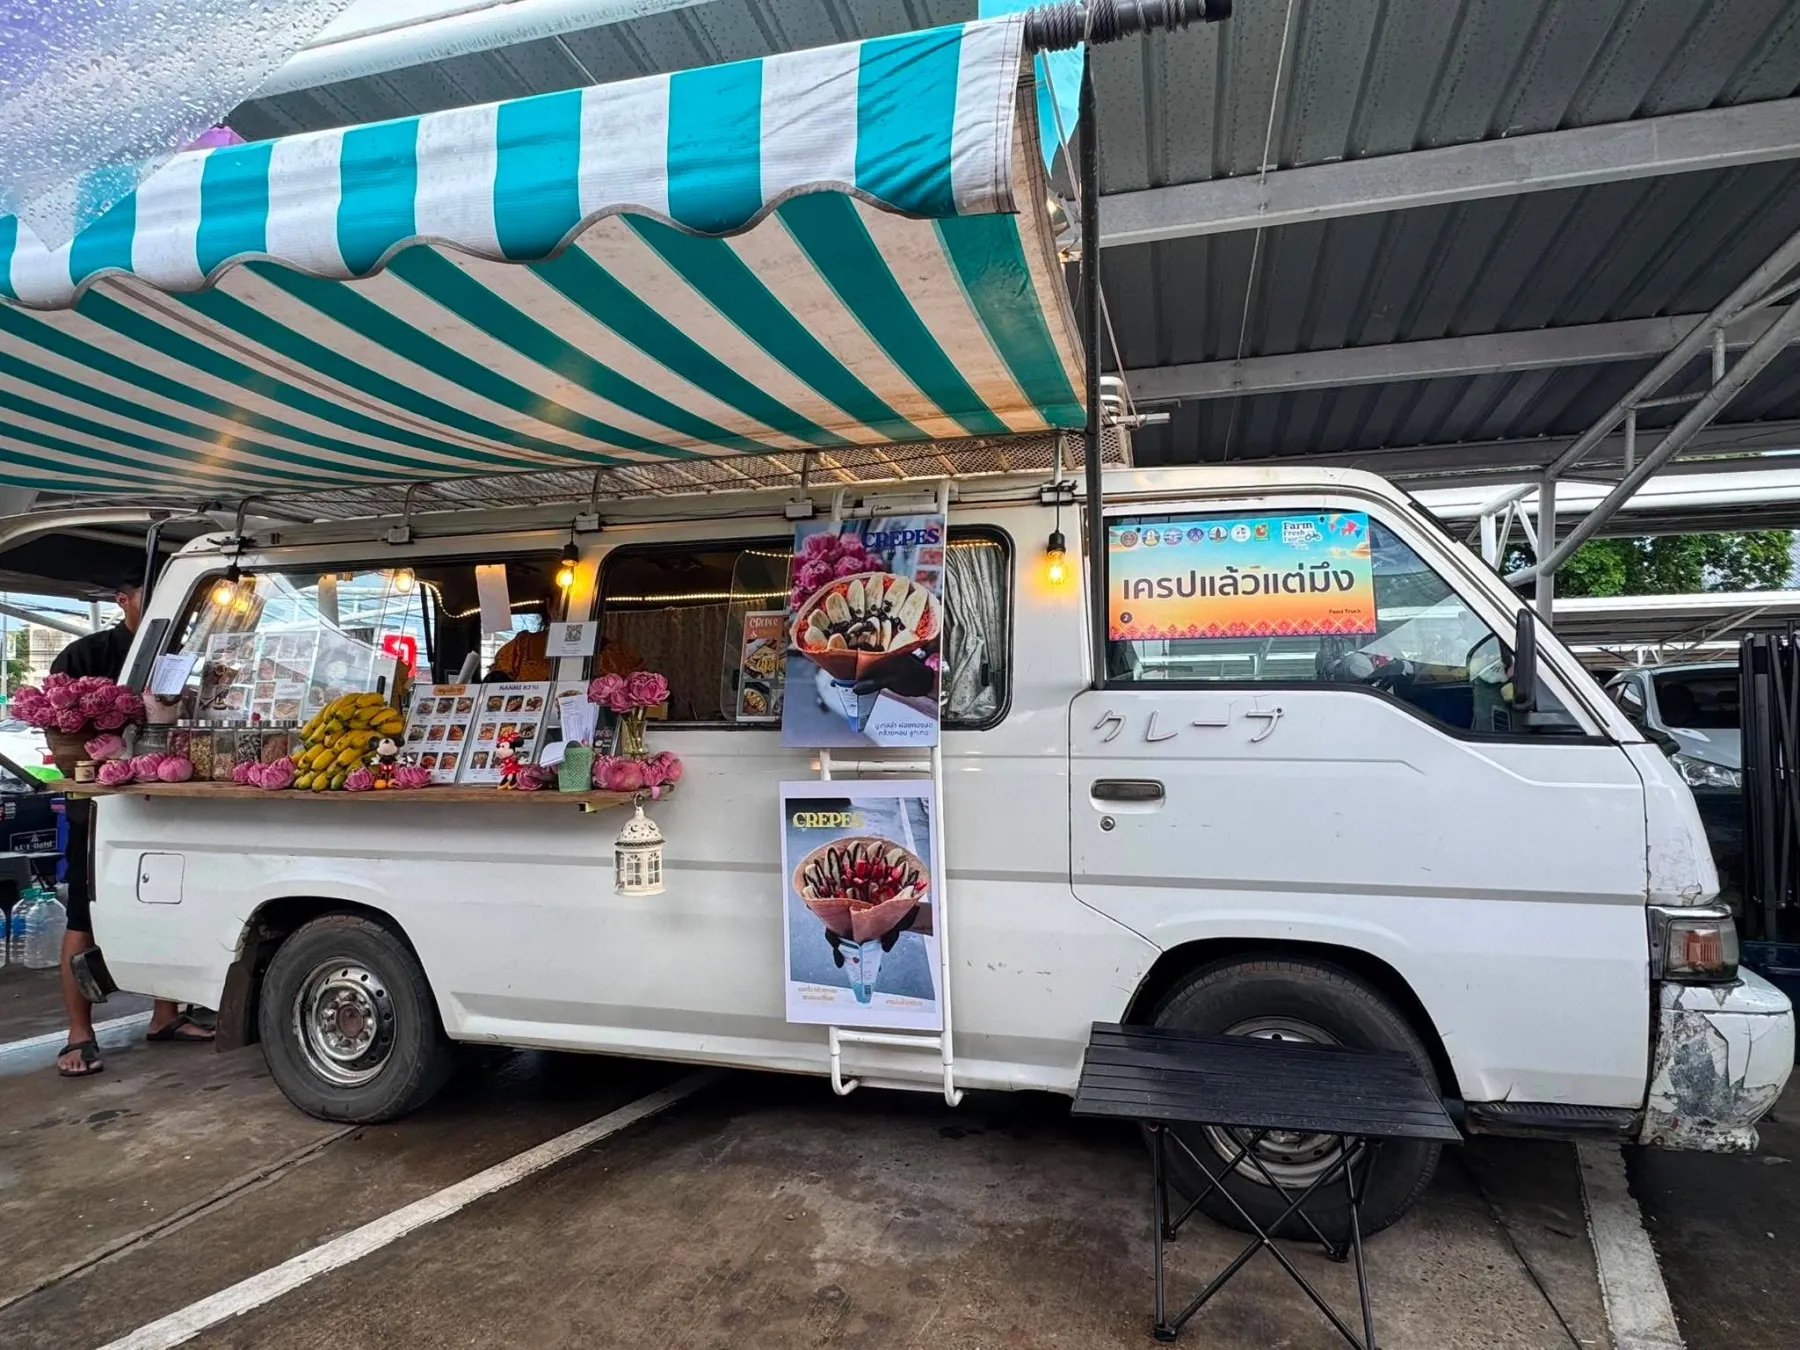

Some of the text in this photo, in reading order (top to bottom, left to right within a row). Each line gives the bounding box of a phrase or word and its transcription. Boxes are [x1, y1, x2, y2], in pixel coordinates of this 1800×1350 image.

[862, 528, 940, 548] CREPES
[1283, 521, 1313, 530] Farm
[1123, 561, 1355, 600] เครปแล้วแต่มึง
[1094, 706, 1285, 743] クレープ
